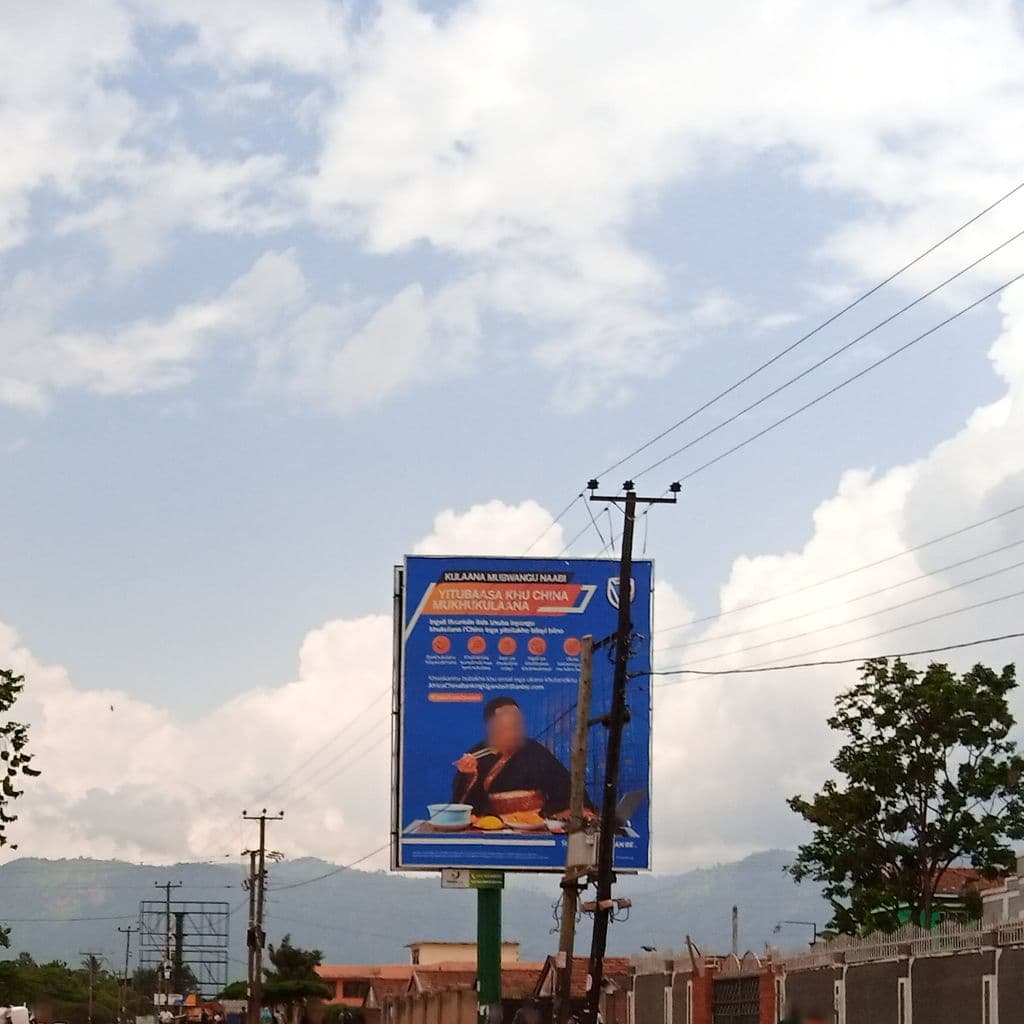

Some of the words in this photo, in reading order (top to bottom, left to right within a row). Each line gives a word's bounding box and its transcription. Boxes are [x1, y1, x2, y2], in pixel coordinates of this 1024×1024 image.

[444, 572, 485, 582] KULAANA
[504, 590, 530, 601] KHU
[532, 590, 569, 602] CHINA
